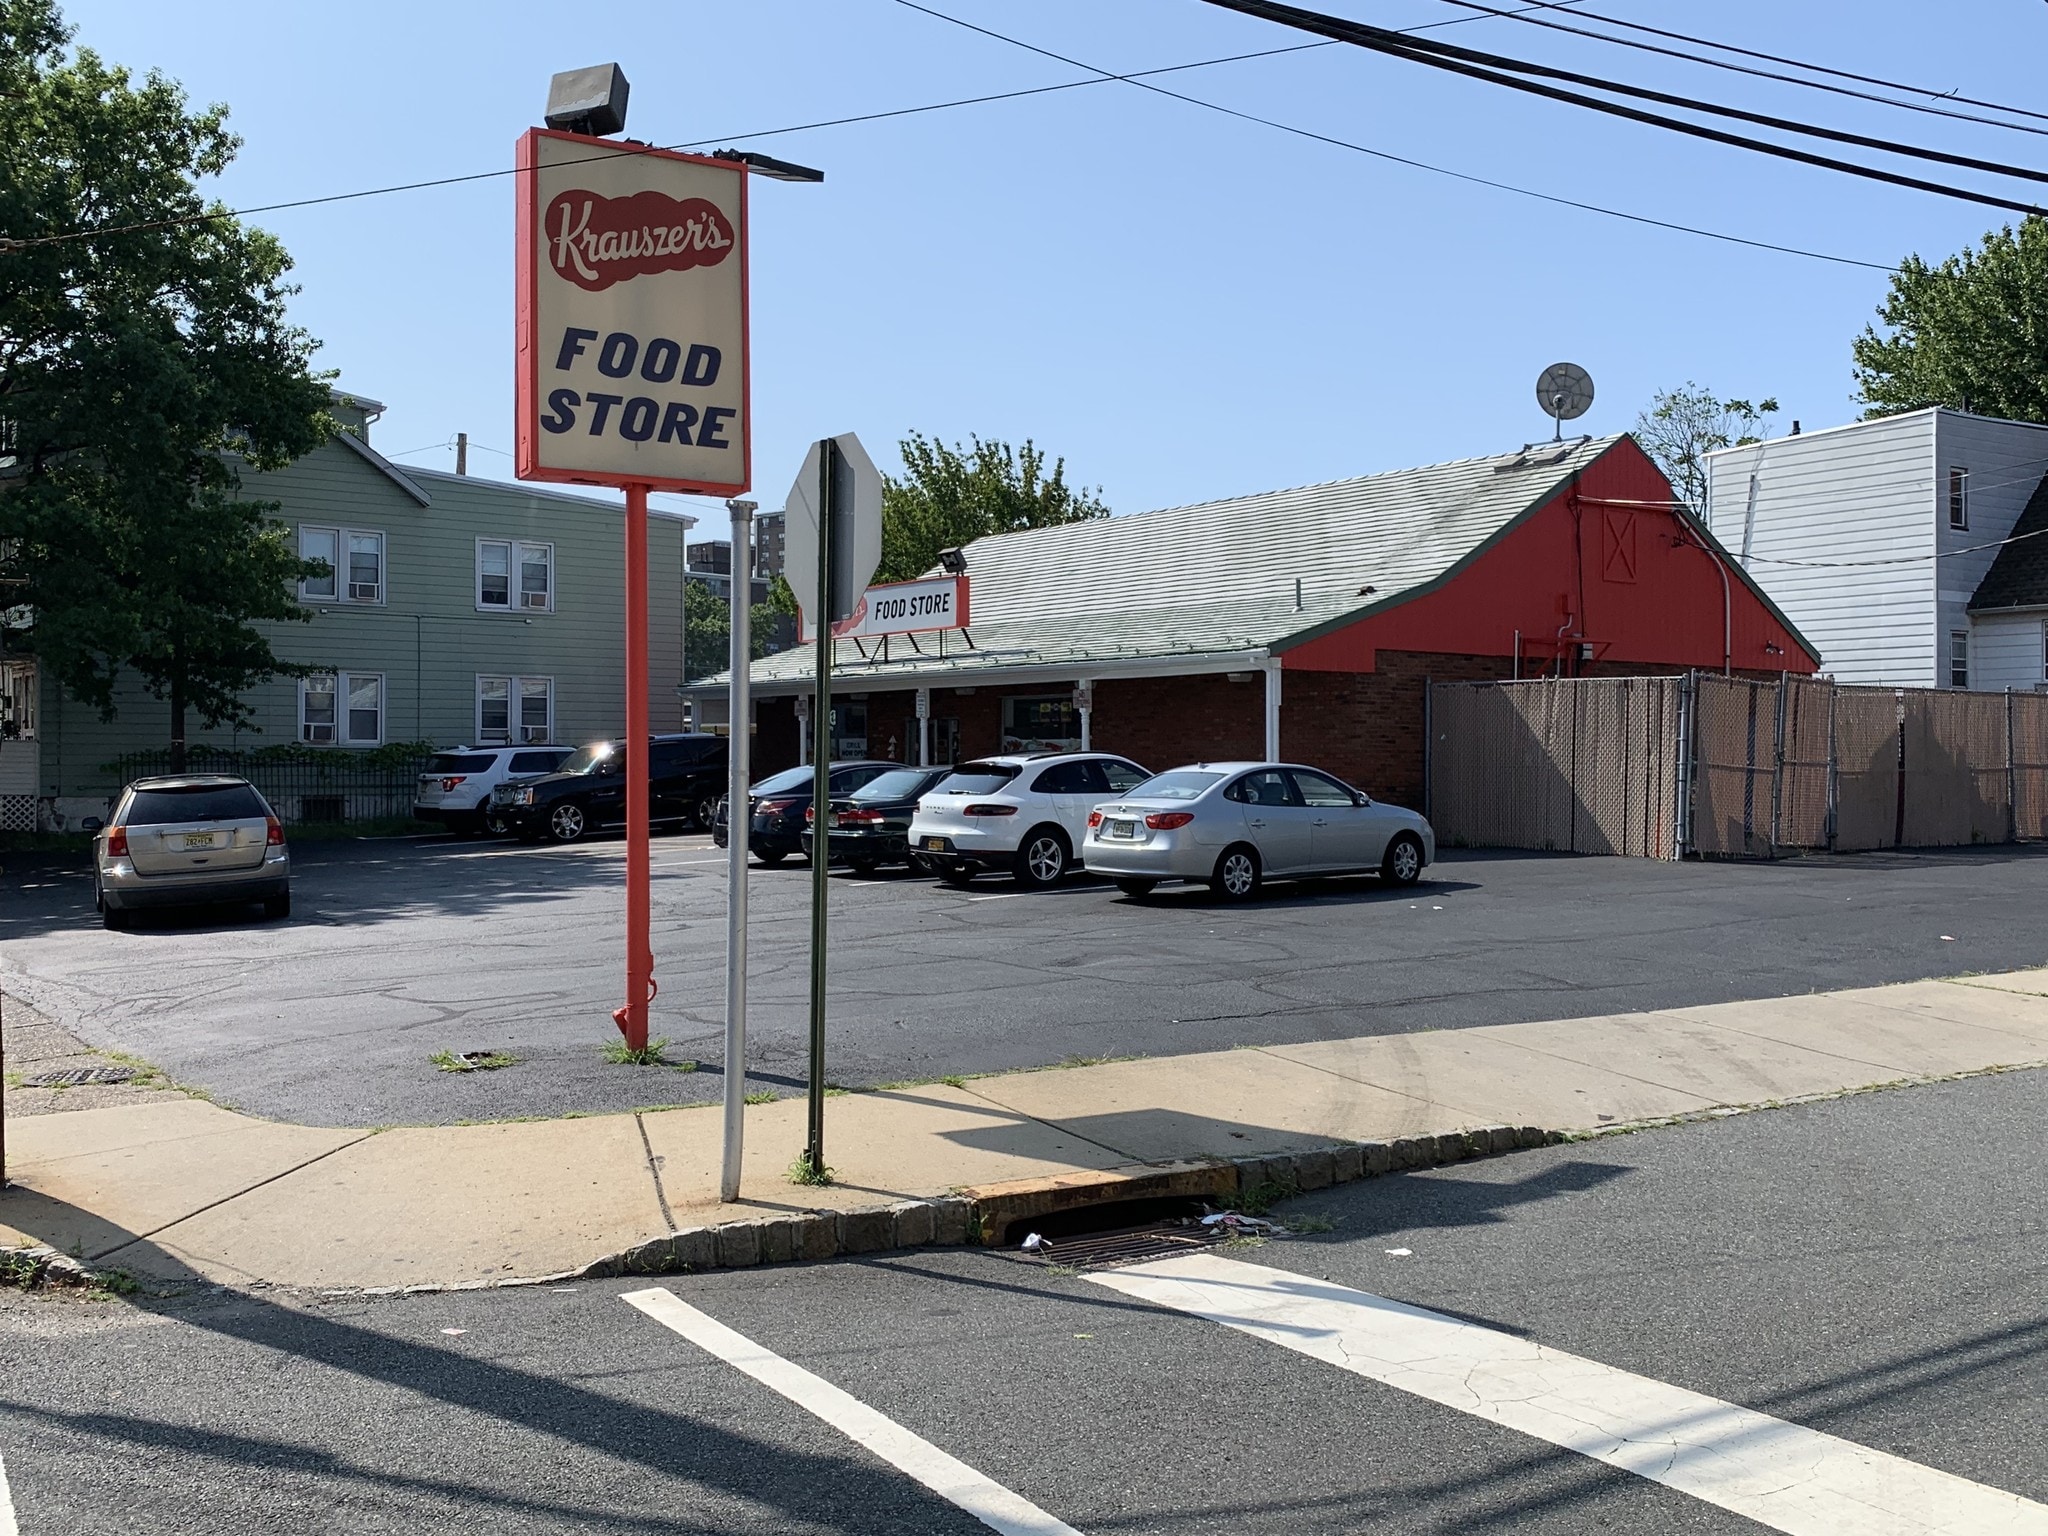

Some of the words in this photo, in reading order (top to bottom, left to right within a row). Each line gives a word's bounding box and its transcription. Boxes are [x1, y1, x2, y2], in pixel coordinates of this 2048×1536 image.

[554, 200, 731, 281] Krauszer's
[555, 327, 722, 387] FOOD
[540, 388, 737, 449] STORE
[875, 598, 906, 621] FOOD
[910, 592, 951, 617] STORE
